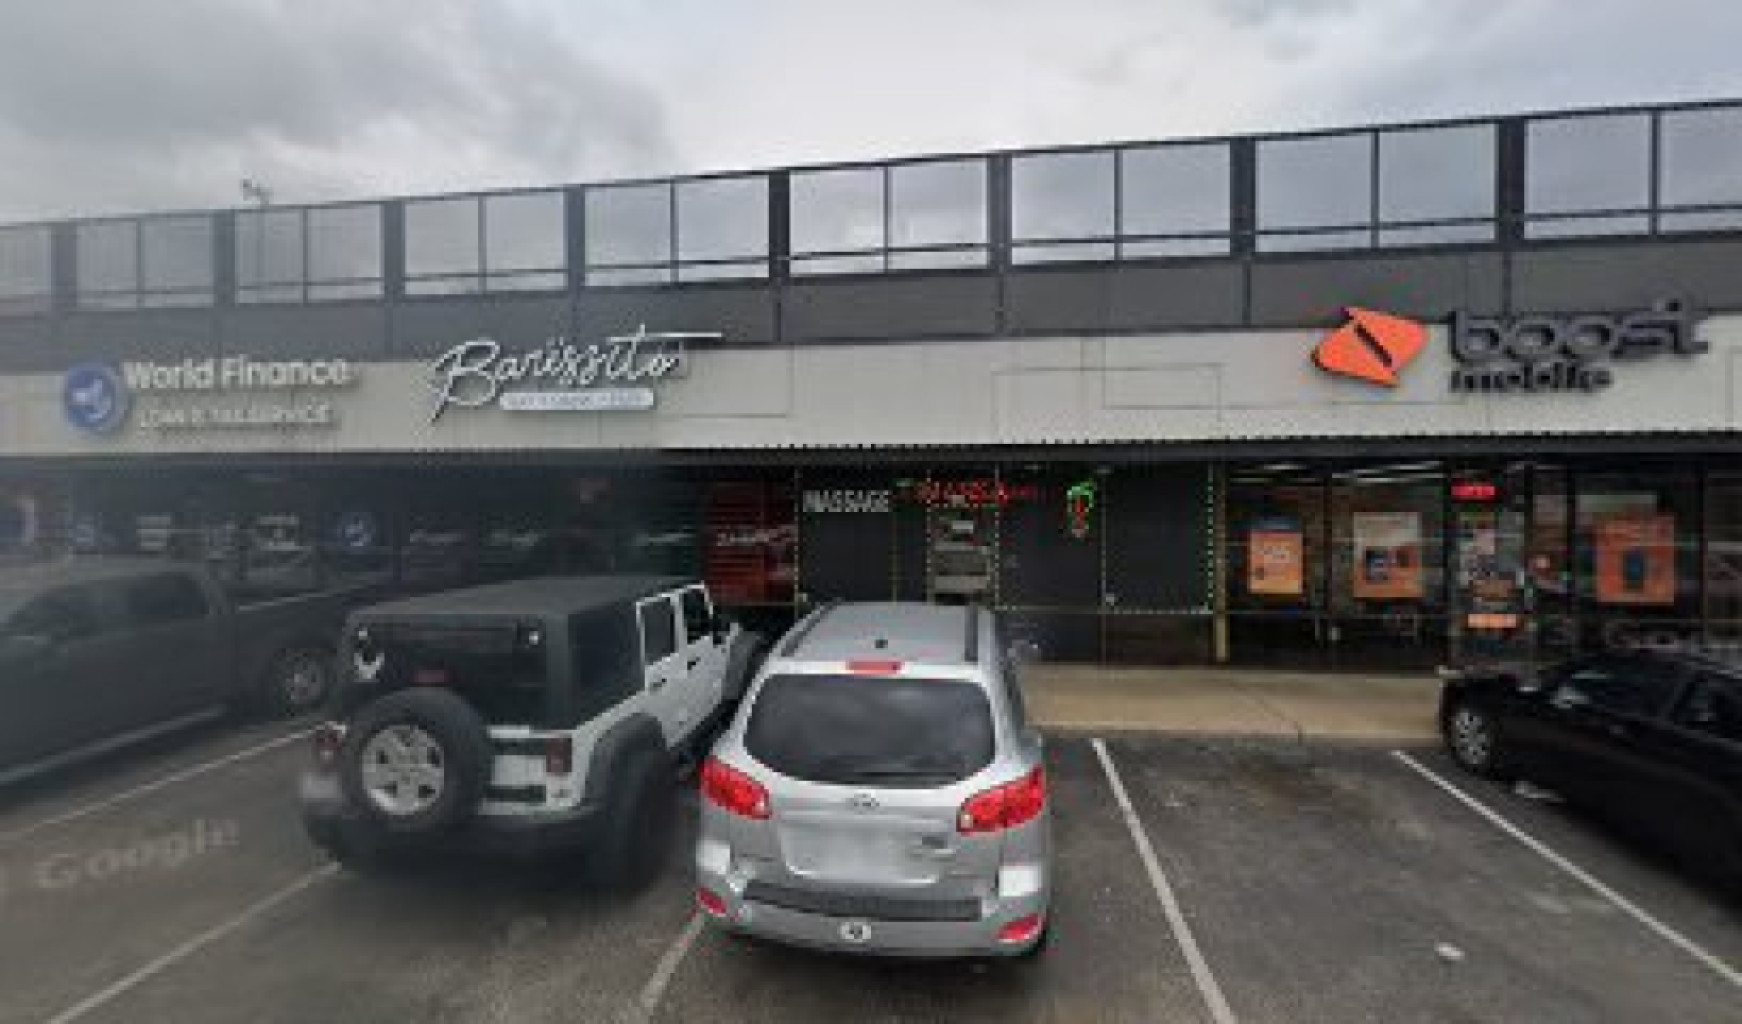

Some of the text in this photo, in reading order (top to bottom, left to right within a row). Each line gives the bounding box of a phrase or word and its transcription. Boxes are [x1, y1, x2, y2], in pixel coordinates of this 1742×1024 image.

[1448, 299, 1709, 360] boost
[123, 354, 352, 389] World Finance
[802, 489, 890, 513] MASSAGE
